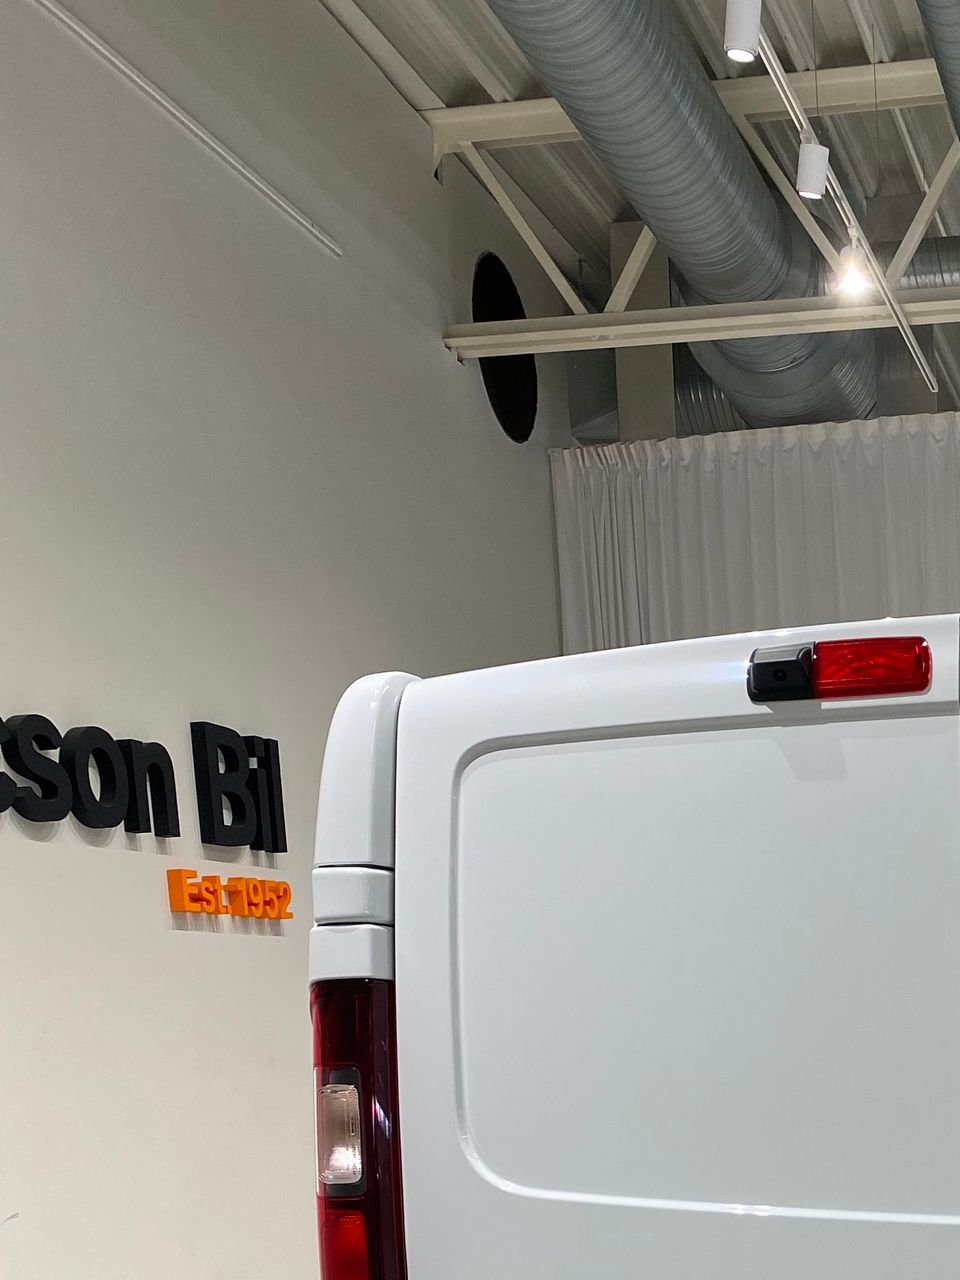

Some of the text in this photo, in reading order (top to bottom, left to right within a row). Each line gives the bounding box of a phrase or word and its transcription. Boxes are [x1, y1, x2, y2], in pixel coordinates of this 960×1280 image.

[190, 721, 288, 853] Bil
[167, 869, 294, 919] Est. 1952
